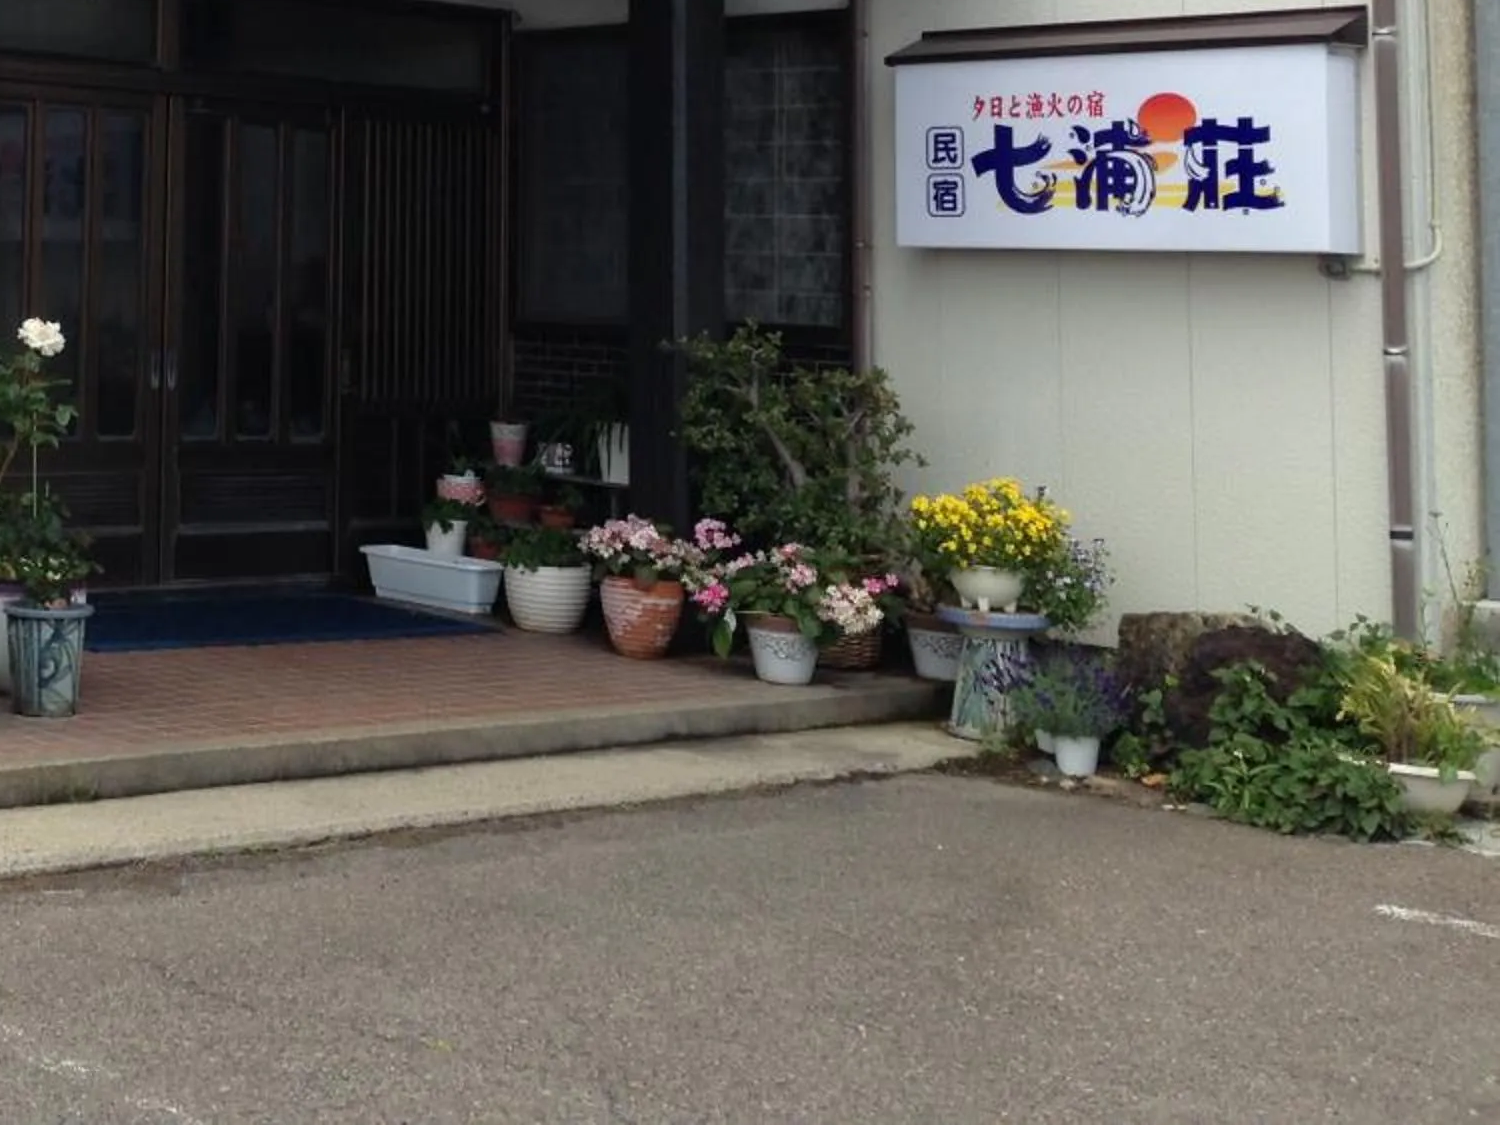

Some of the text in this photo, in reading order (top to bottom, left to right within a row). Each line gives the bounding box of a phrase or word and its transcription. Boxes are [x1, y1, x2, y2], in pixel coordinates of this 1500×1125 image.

[972, 91, 1105, 121] 夕日と漁火の宿
[931, 131, 960, 213] 民宿
[971, 117, 1286, 216] 七浦荘
